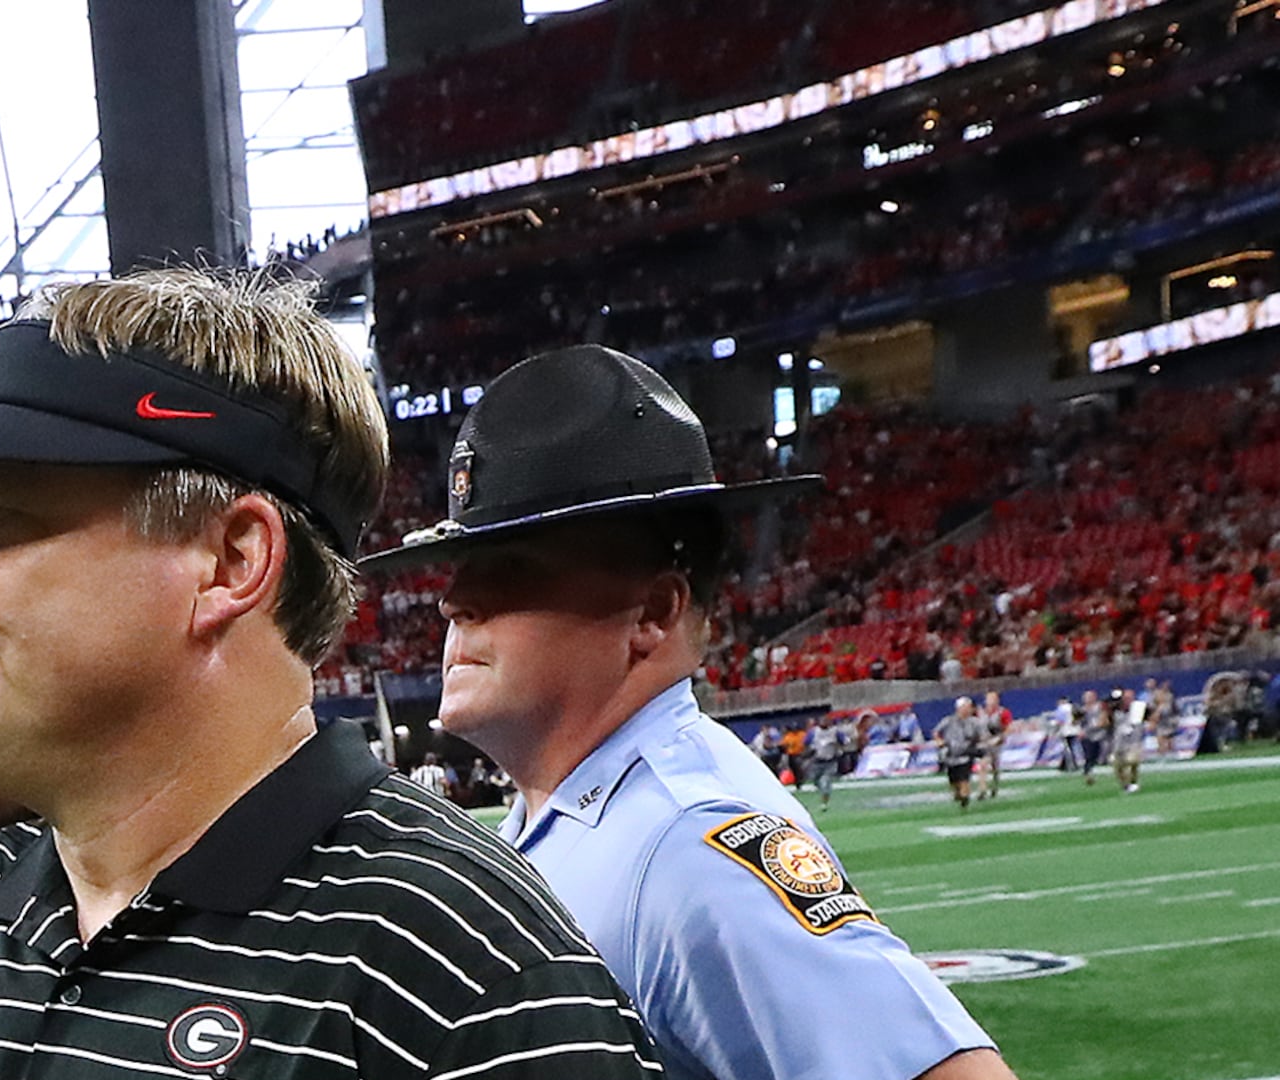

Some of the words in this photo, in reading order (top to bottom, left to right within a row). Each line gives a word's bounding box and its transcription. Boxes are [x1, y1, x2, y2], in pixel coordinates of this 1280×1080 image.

[396, 394, 439, 419] 0:22
[719, 814, 788, 849] GEORGIA
[172, 1009, 240, 1063] G
